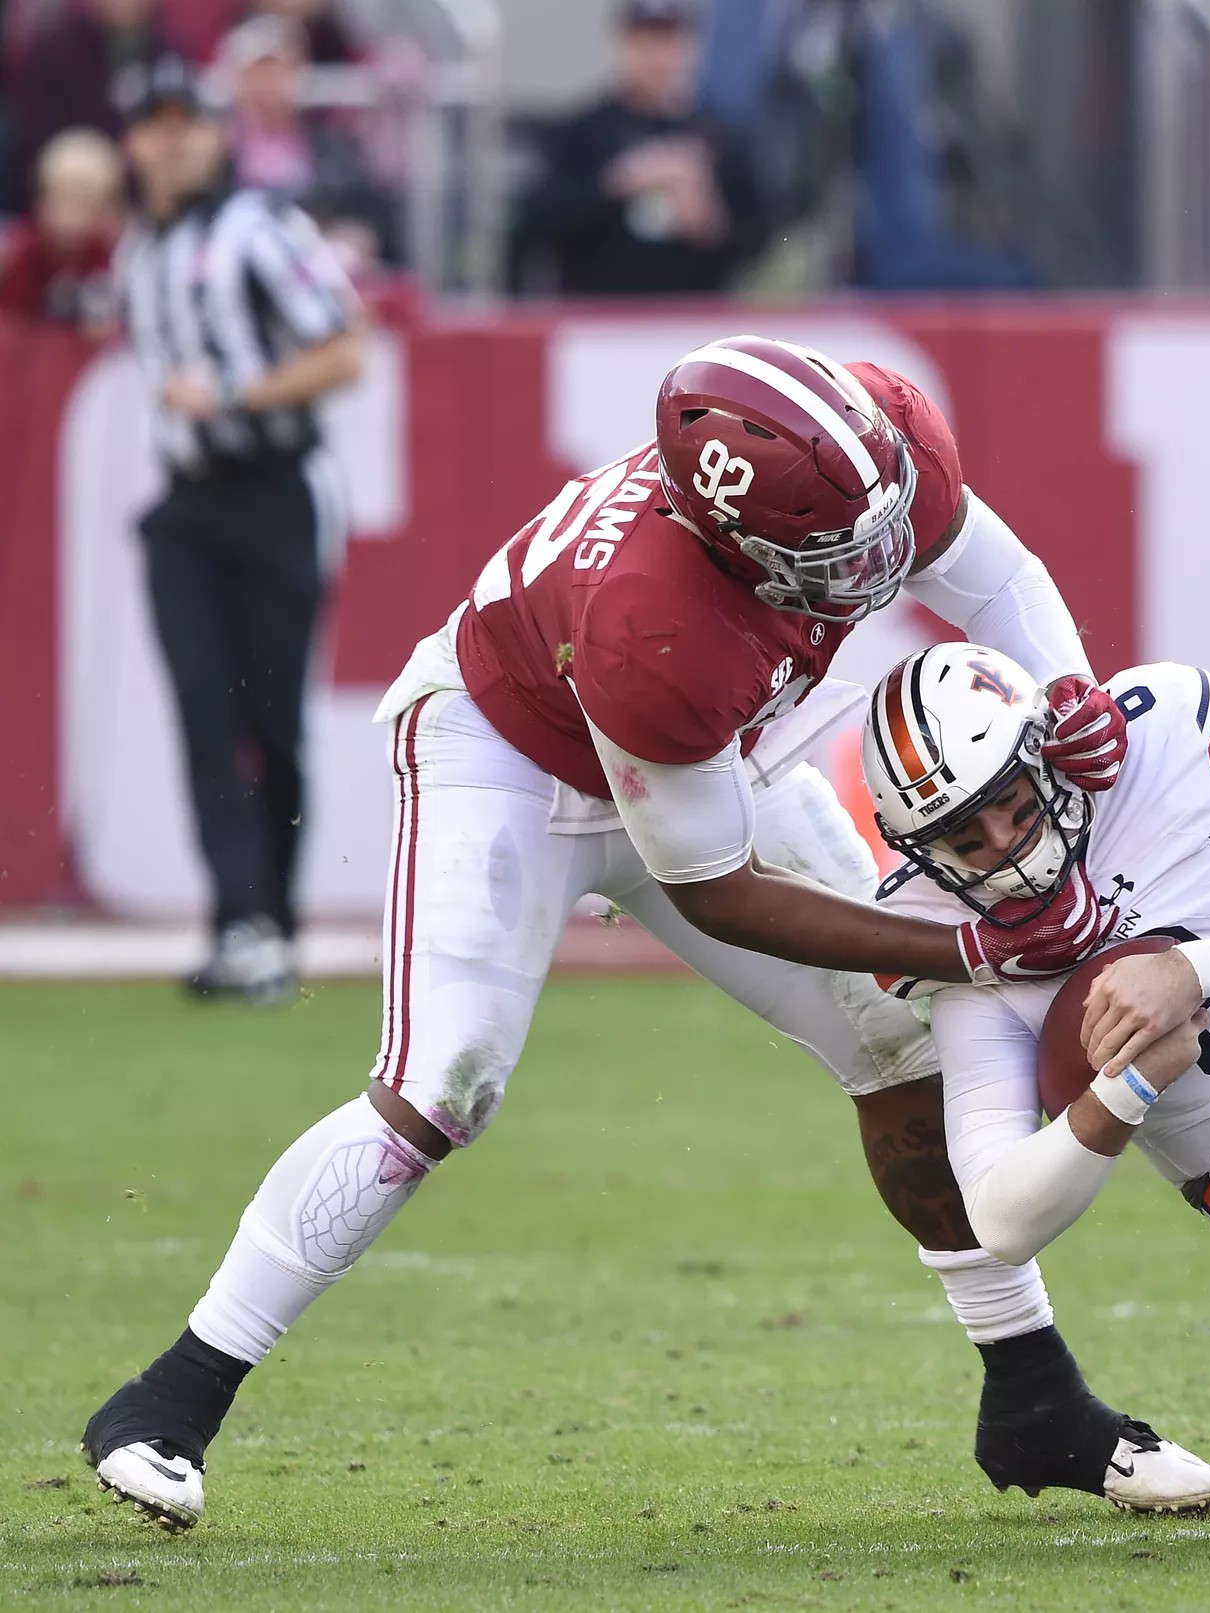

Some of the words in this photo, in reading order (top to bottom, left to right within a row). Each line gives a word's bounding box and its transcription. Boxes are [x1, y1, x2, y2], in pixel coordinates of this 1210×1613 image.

[692, 439, 755, 519] 92
[871, 497, 895, 524] BAMA
[817, 533, 843, 543] NIKE
[917, 792, 951, 818] TIGERS
